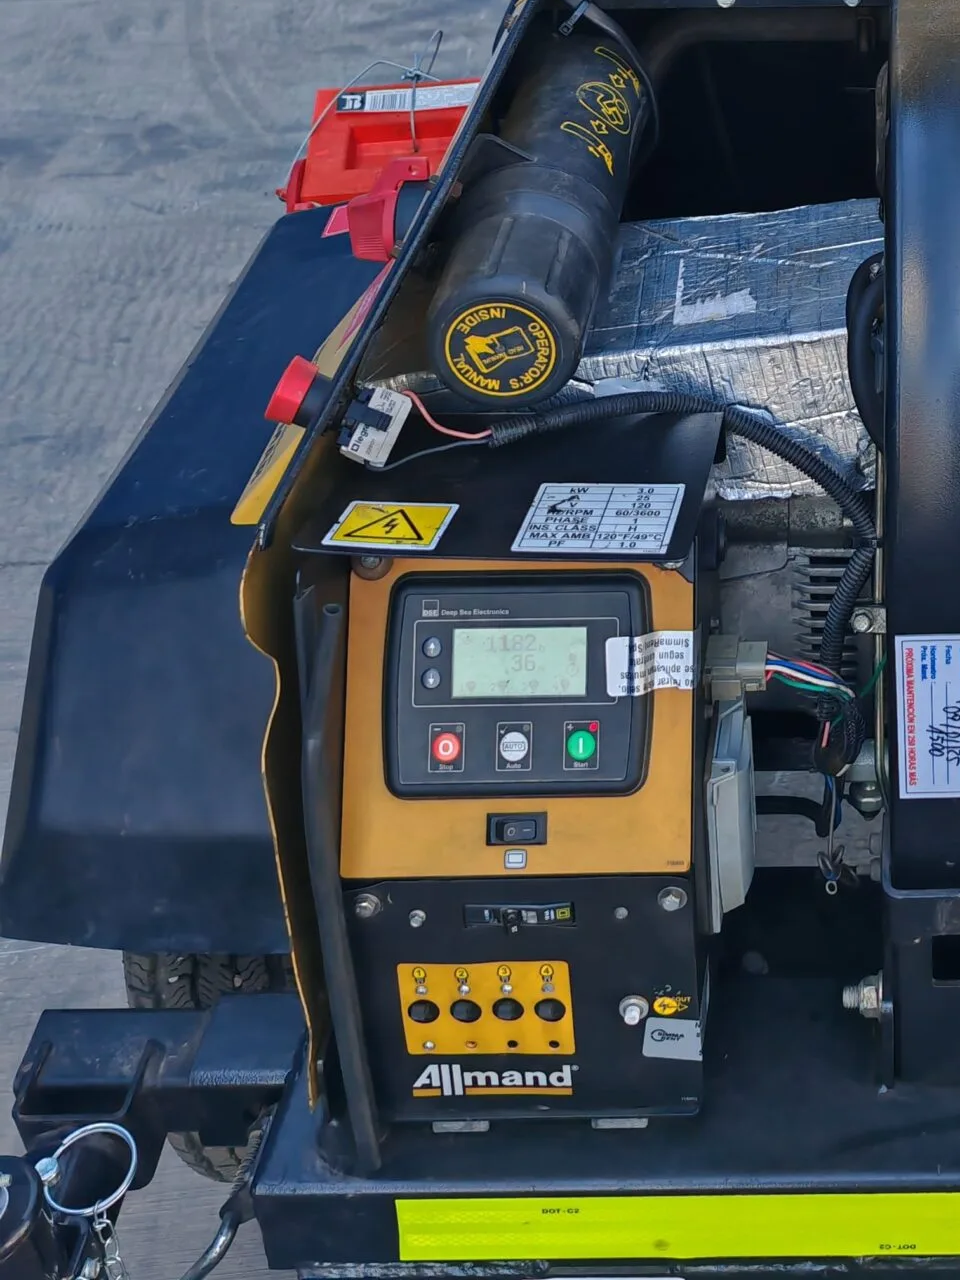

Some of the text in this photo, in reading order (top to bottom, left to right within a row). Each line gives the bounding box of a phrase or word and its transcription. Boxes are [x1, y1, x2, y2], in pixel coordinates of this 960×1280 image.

[456, 308, 506, 334] INSIDE
[453, 322, 549, 390] OPERATOR'S MANUAL
[545, 516, 588, 524] PHASE
[554, 524, 596, 532] CLASS
[561, 532, 591, 540] AMB
[597, 532, 662, 541] 120°F/49°C
[423, 609, 439, 617] DSE
[441, 609, 458, 617] Deep
[485, 634, 537, 653] 1182
[658, 651, 684, 660] segun
[511, 654, 536, 672] 36
[905, 647, 914, 680] PRÓXIMA
[905, 680, 916, 724] MANTENCIÓN
[907, 725, 915, 735] EN
[504, 743, 523, 751] AUTO
[908, 747, 916, 771] HORAS
[439, 763, 454, 771] Stop
[909, 771, 917, 787] MÁS
[416, 969, 422, 977] 1
[458, 969, 465, 977] 2
[502, 967, 508, 975] 3
[544, 967, 551, 976] 4
